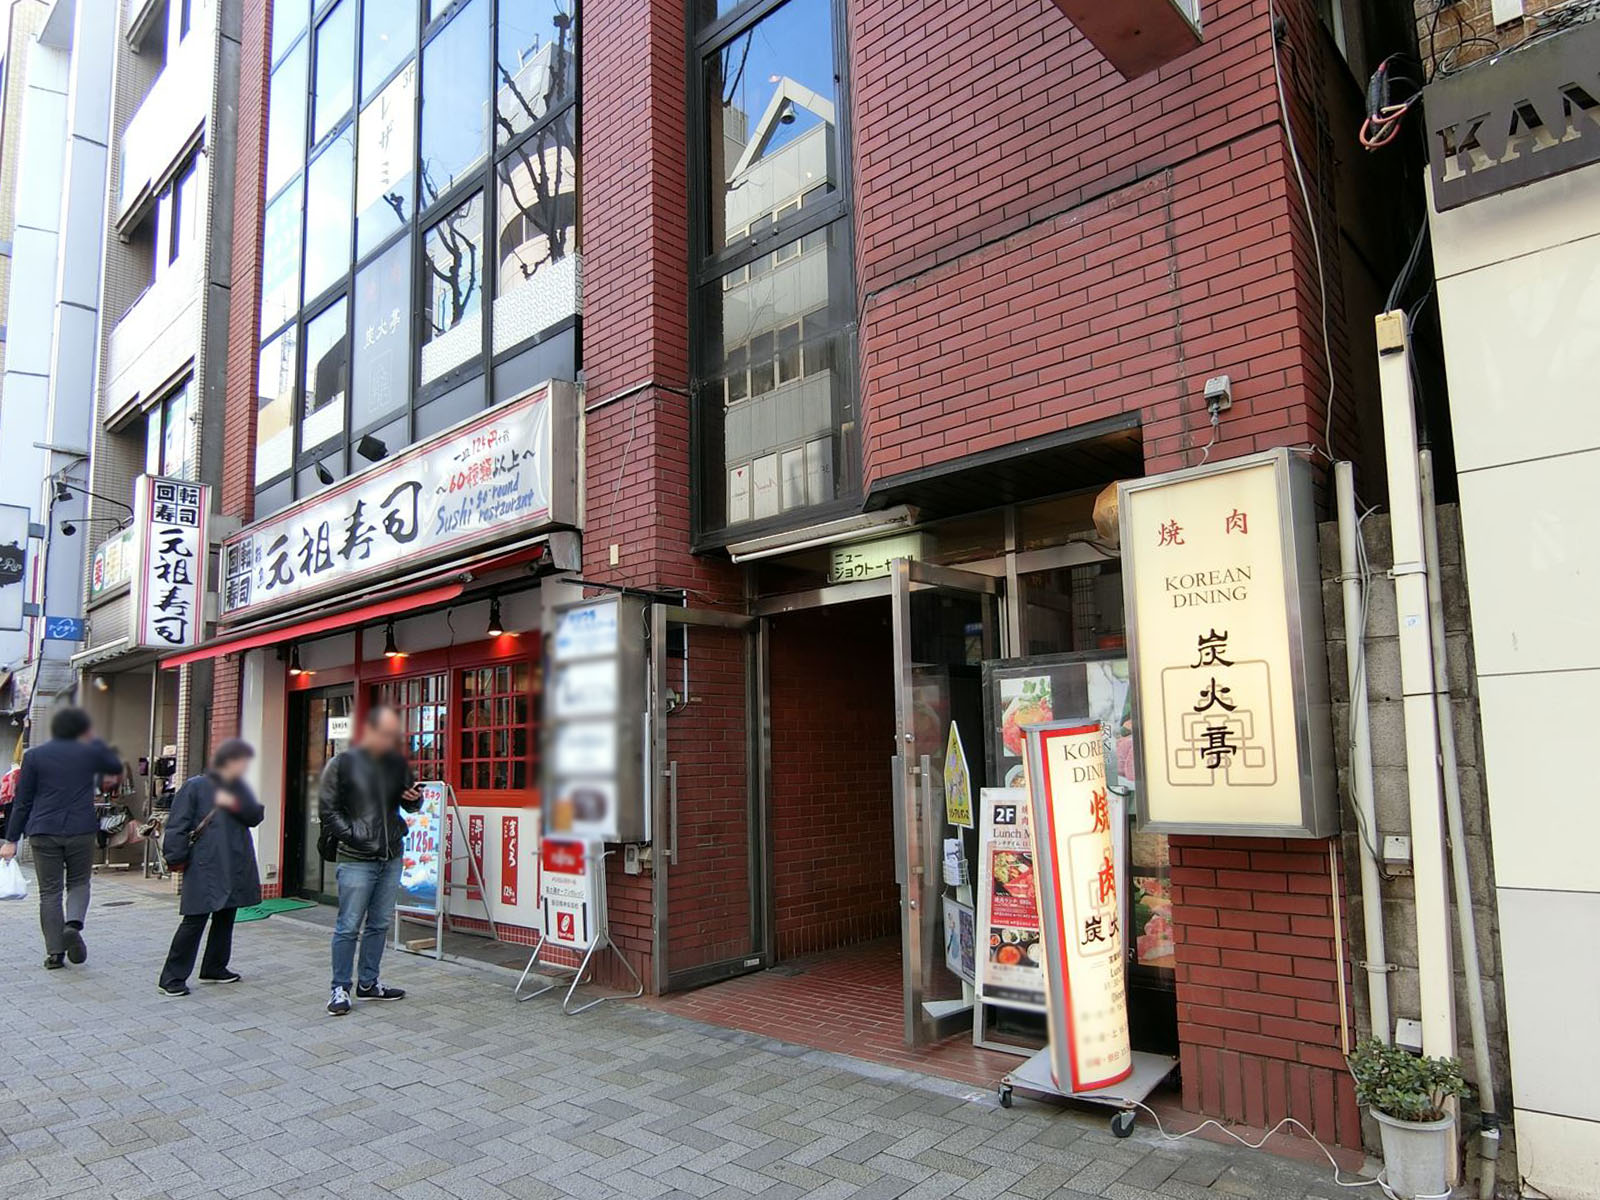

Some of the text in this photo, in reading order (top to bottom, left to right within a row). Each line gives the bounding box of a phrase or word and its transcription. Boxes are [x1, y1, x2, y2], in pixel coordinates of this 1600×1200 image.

[436, 498, 474, 535] Sushi
[478, 488, 535, 524] restaurant
[266, 480, 423, 591] 元祖寿司
[835, 553, 863, 566] ニュー
[154, 528, 194, 645] 元祖寿司
[1164, 566, 1252, 592] KOREAN
[1173, 585, 1248, 609] DINING
[1190, 627, 1238, 770] 炭火亭
[995, 807, 1015, 823] 2F
[508, 819, 518, 868] まぐろ
[993, 828, 1022, 839] Lunch
